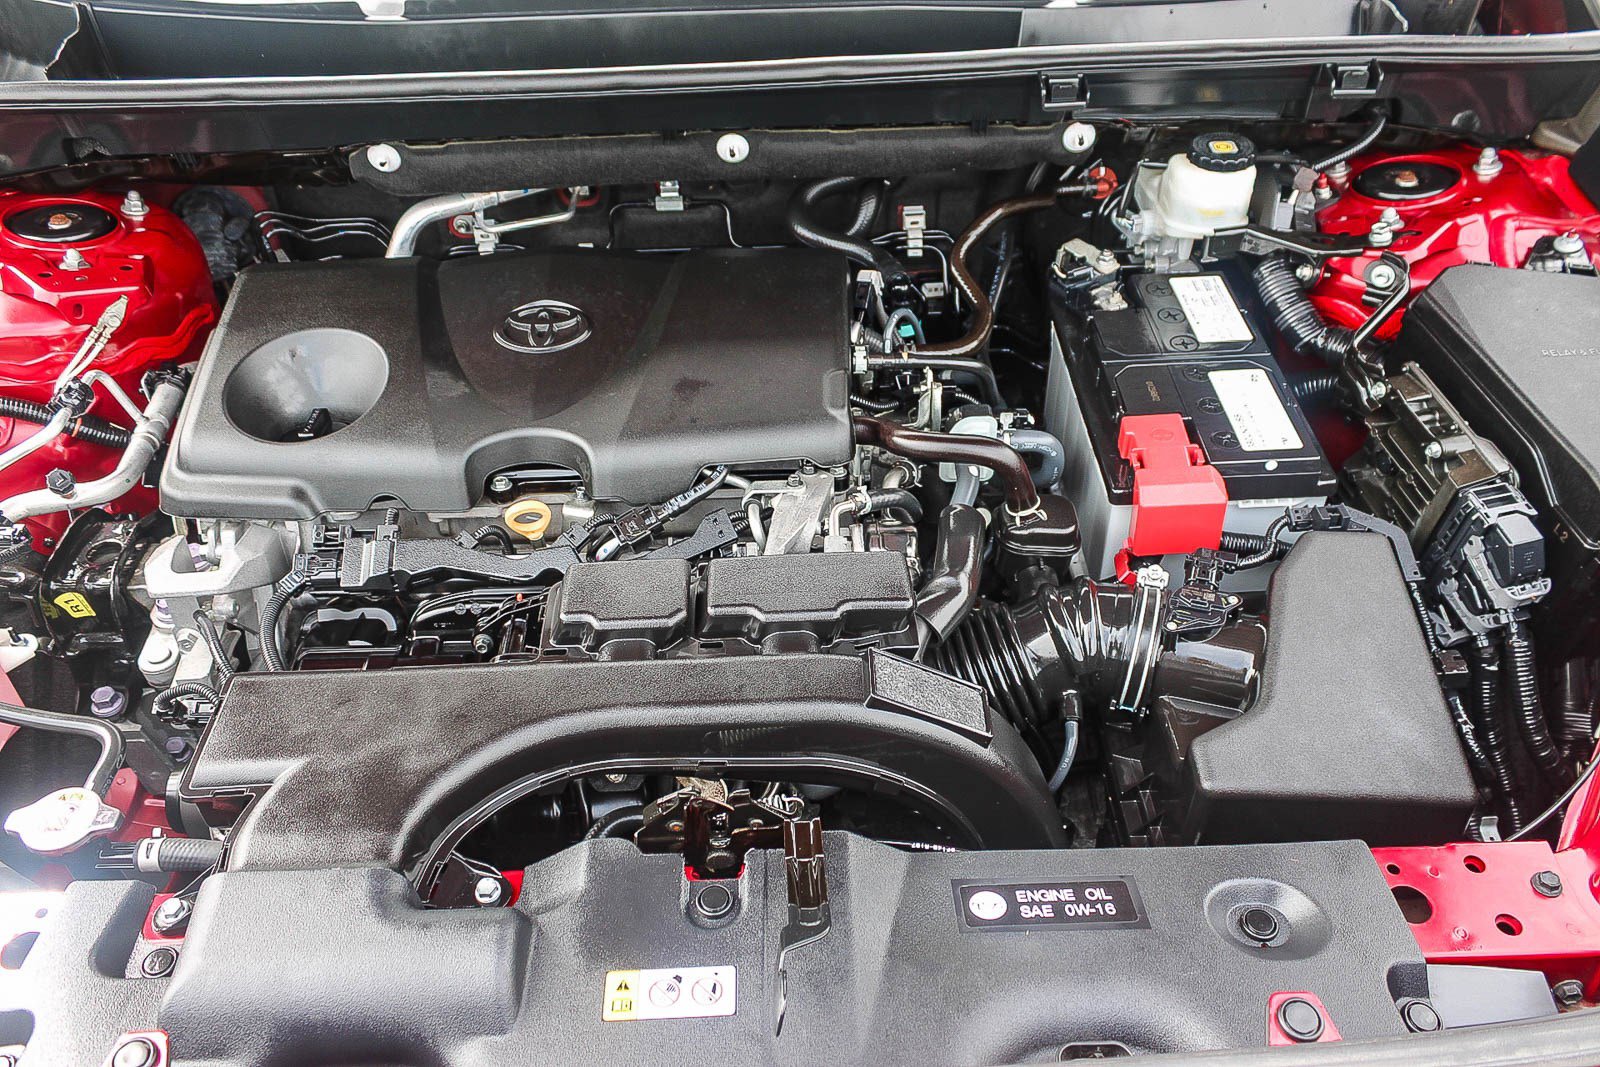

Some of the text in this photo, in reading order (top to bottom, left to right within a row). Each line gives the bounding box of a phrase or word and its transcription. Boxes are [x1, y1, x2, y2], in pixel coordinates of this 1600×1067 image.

[1541, 349, 1577, 357] RELAY
[63, 598, 85, 613] R1
[1015, 887, 1113, 902] ENGINE OIL
[1019, 904, 1055, 918] SAE
[1064, 902, 1117, 917] 0W-16
